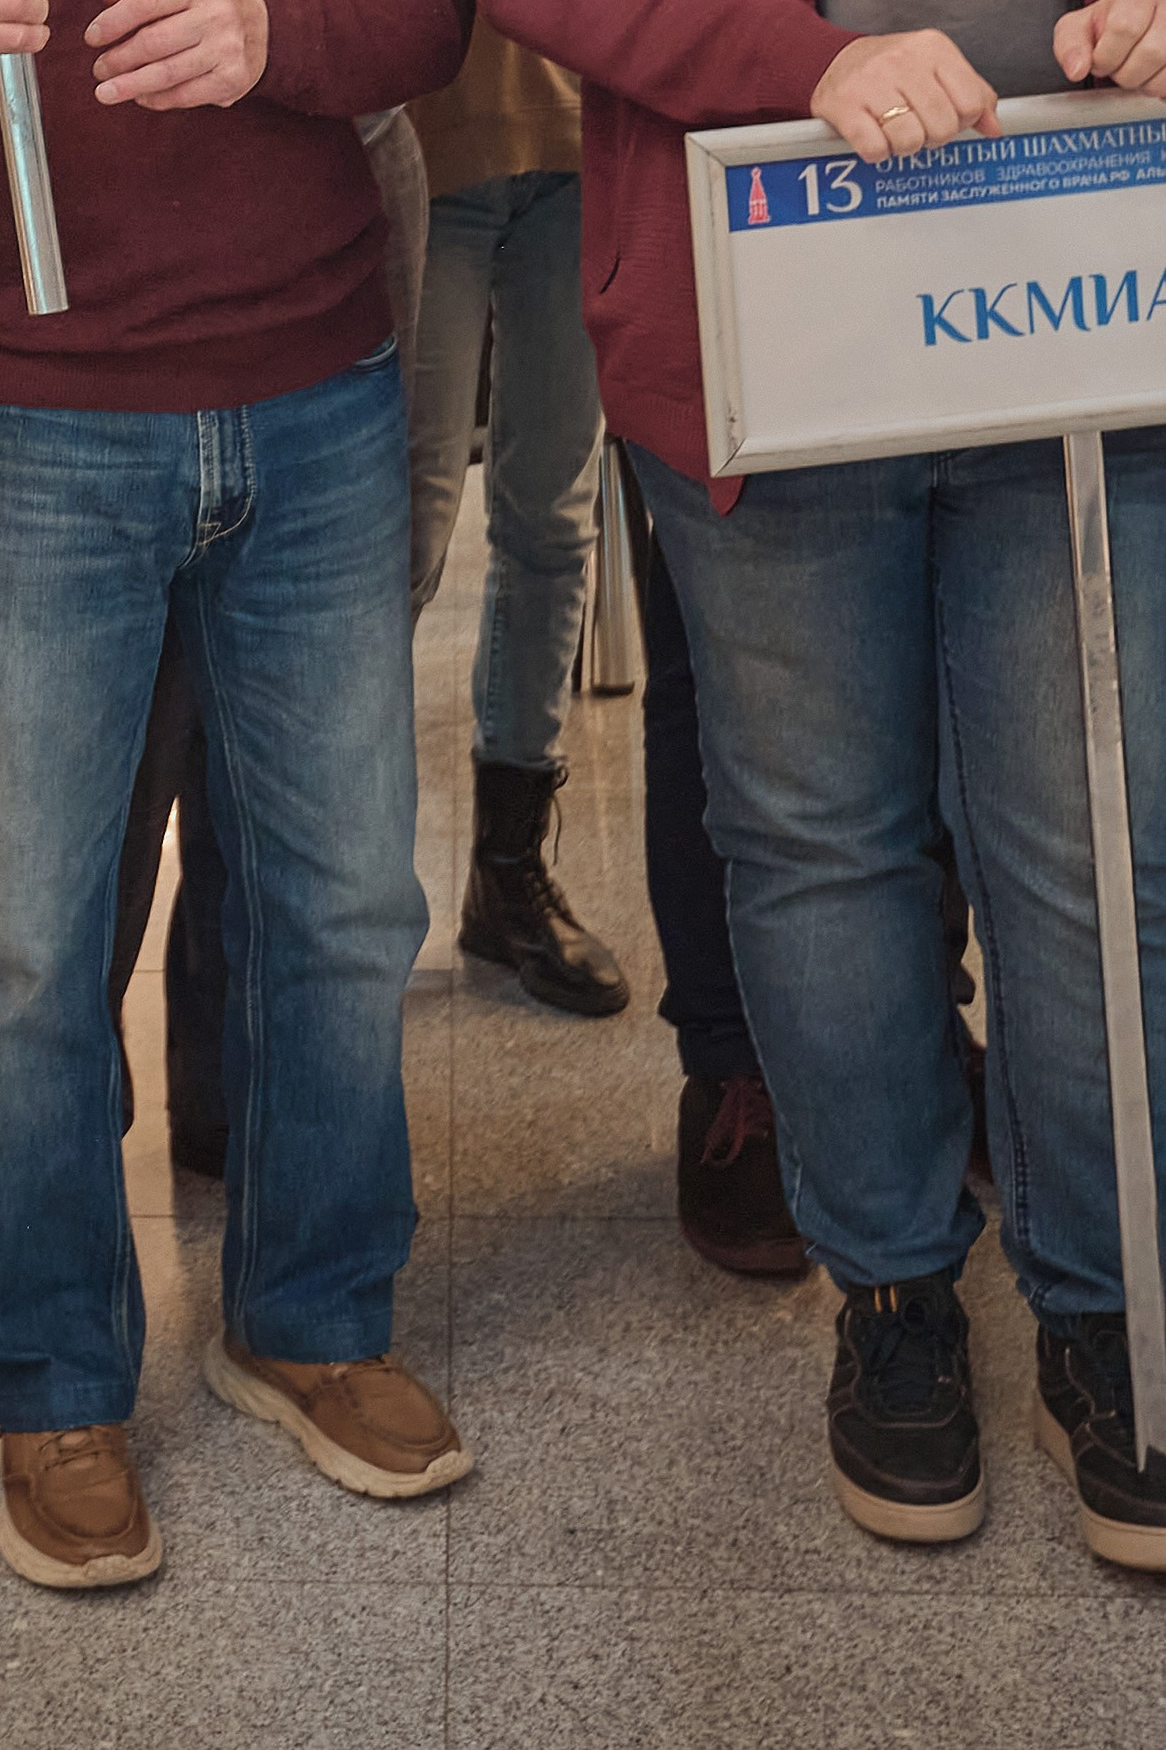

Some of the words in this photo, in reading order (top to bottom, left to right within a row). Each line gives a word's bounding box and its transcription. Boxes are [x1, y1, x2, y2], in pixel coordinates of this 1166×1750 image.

[1023, 122, 1166, 158] ШАХМАТНЫ
[798, 159, 863, 216] 13
[875, 168, 985, 193] РАБОТНИКОВ
[997, 150, 1151, 181] ЗДРАВООХРАНЕНИЯ
[877, 192, 937, 209] ПАМЯТИ
[941, 178, 1059, 204] ЗАСЛУЖЕННОГО
[1063, 173, 1107, 189] ВРАЧА
[1110, 169, 1130, 183] РФ
